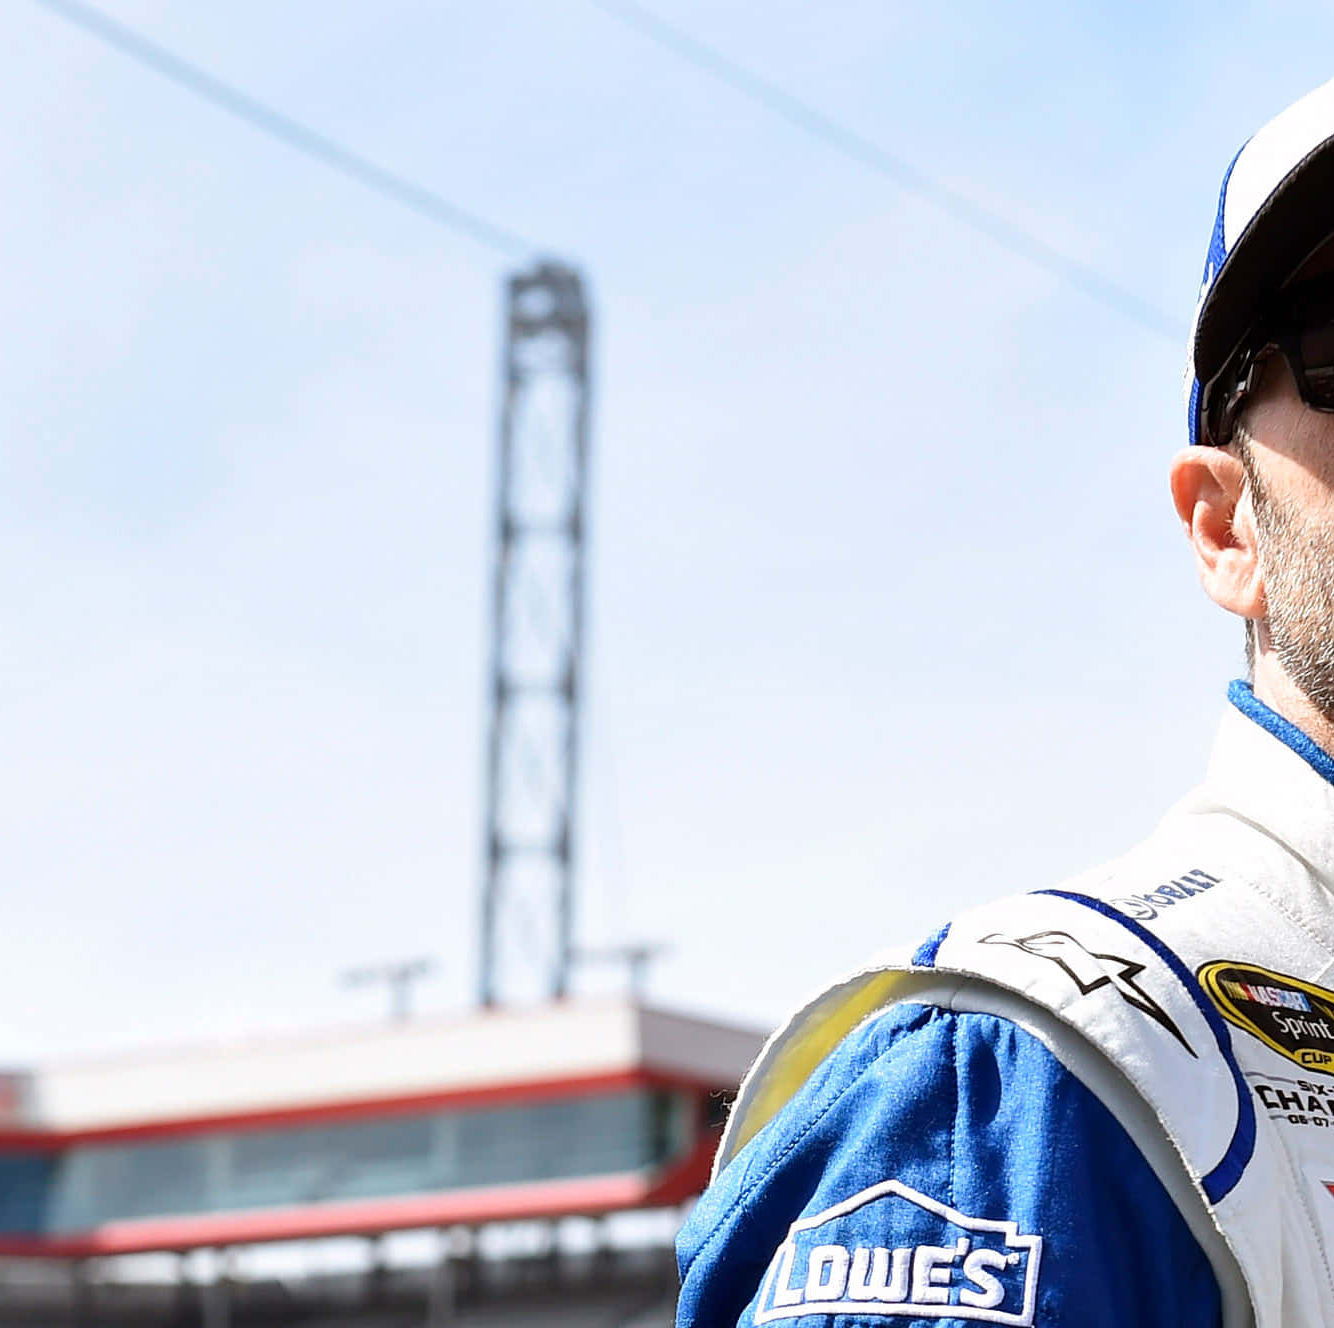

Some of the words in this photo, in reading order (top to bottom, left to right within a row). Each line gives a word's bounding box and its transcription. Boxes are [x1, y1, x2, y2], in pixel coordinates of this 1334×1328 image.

[1247, 984, 1312, 1012] NASCAR
[1301, 1051, 1332, 1065] CUP
[772, 1238, 1007, 1309] LOWE'S
